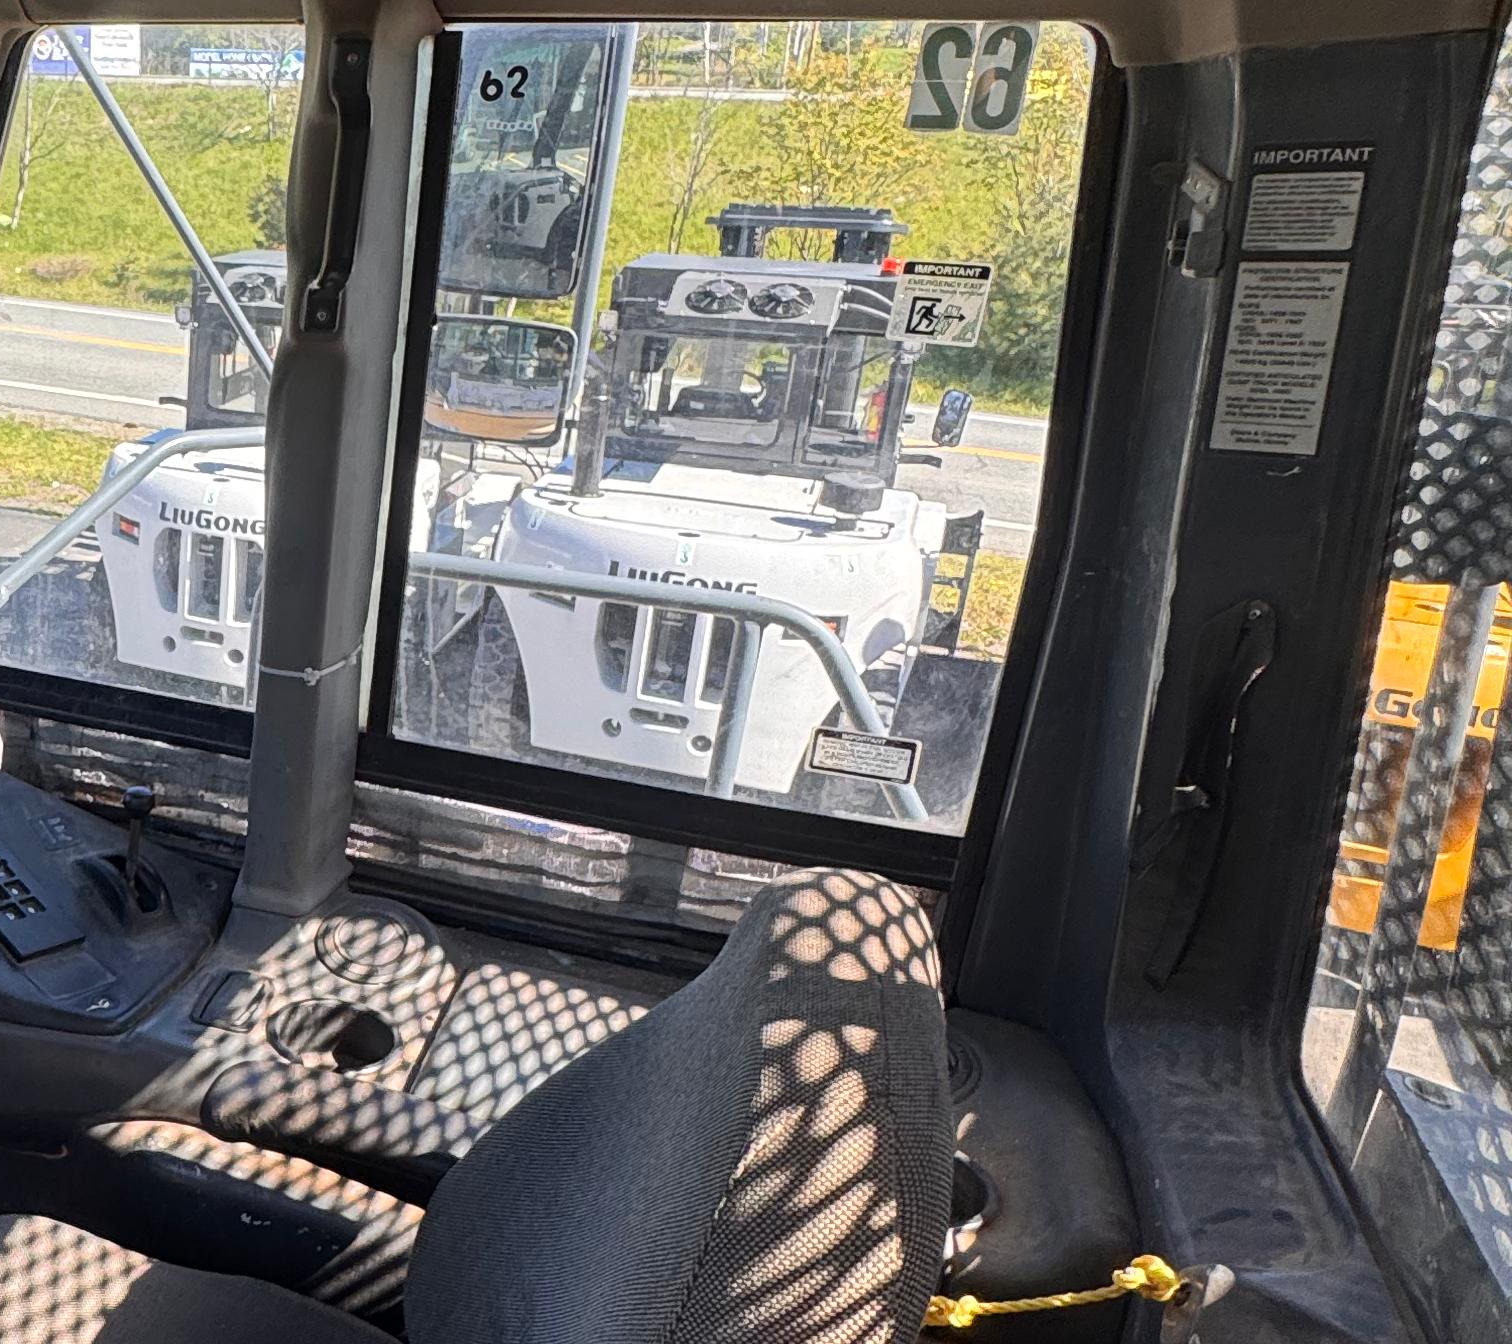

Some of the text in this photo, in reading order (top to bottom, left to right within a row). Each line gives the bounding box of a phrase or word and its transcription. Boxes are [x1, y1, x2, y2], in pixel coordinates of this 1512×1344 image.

[479, 65, 529, 102] 62
[1252, 147, 1376, 165] IMPORTANT
[914, 264, 983, 278] IMPORTANT
[841, 733, 888, 746] IMPORTANT
